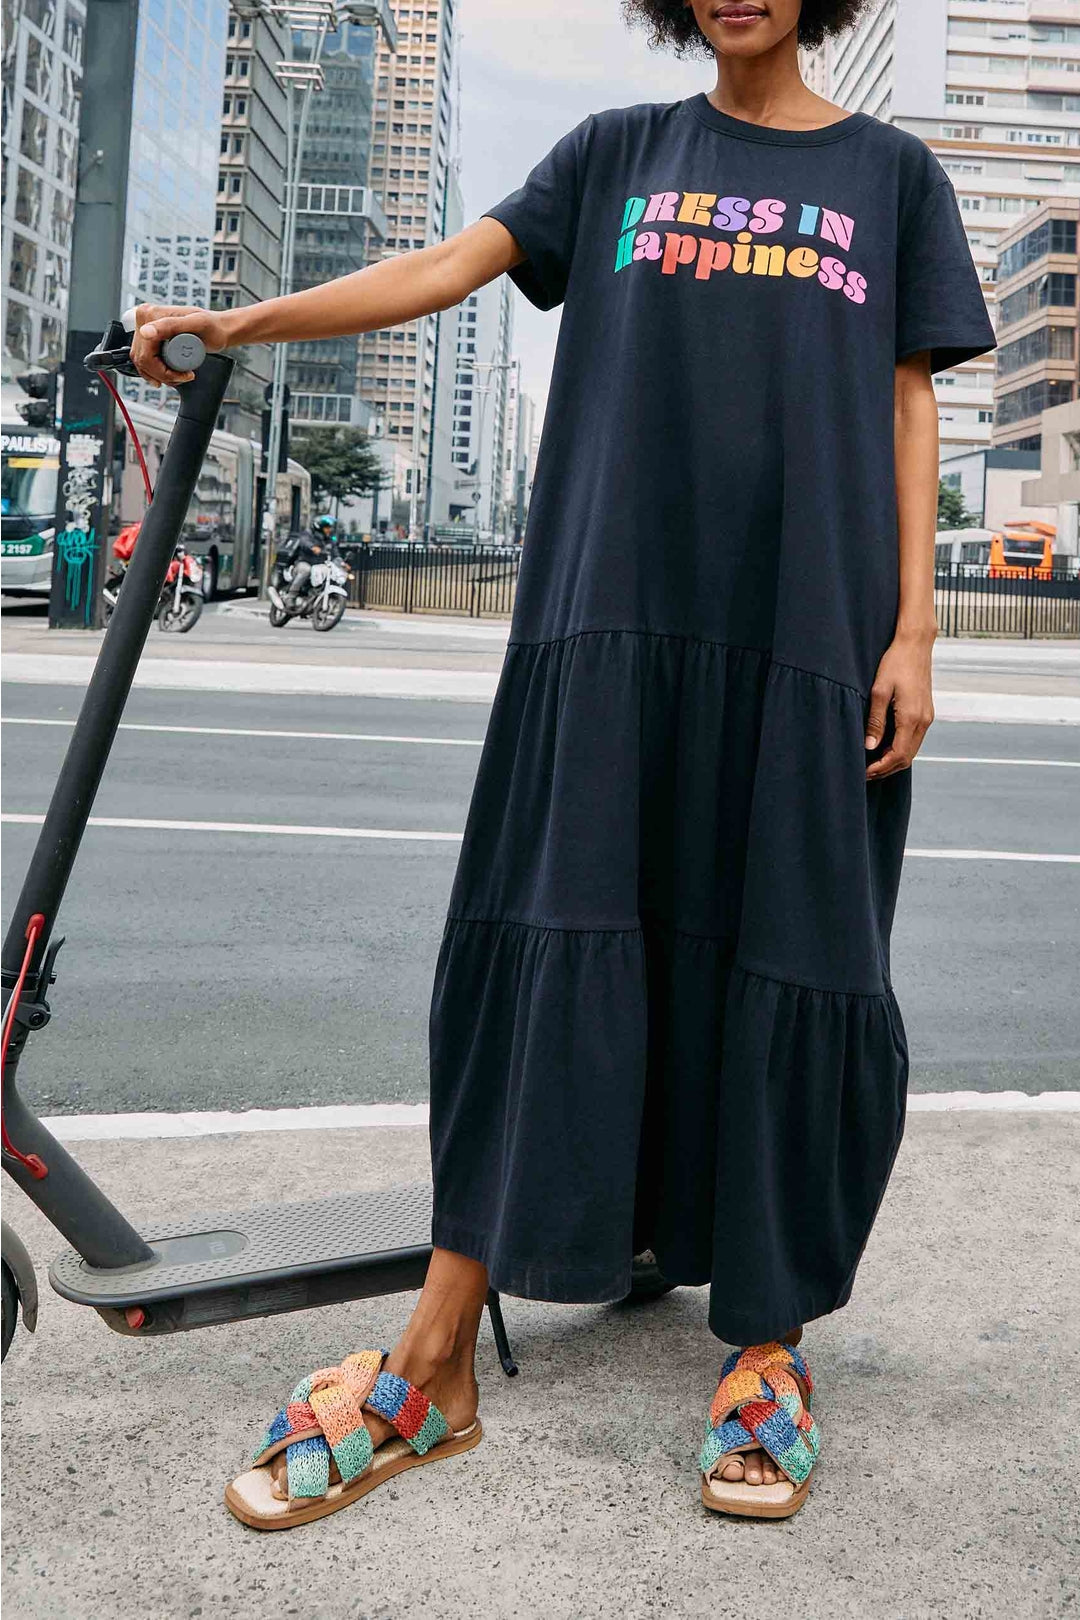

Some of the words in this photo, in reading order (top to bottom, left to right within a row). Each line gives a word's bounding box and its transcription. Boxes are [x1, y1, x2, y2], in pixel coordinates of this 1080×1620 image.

[620, 191, 787, 234] DRESS
[798, 203, 855, 252] IN
[614, 229, 868, 304] Happiness
